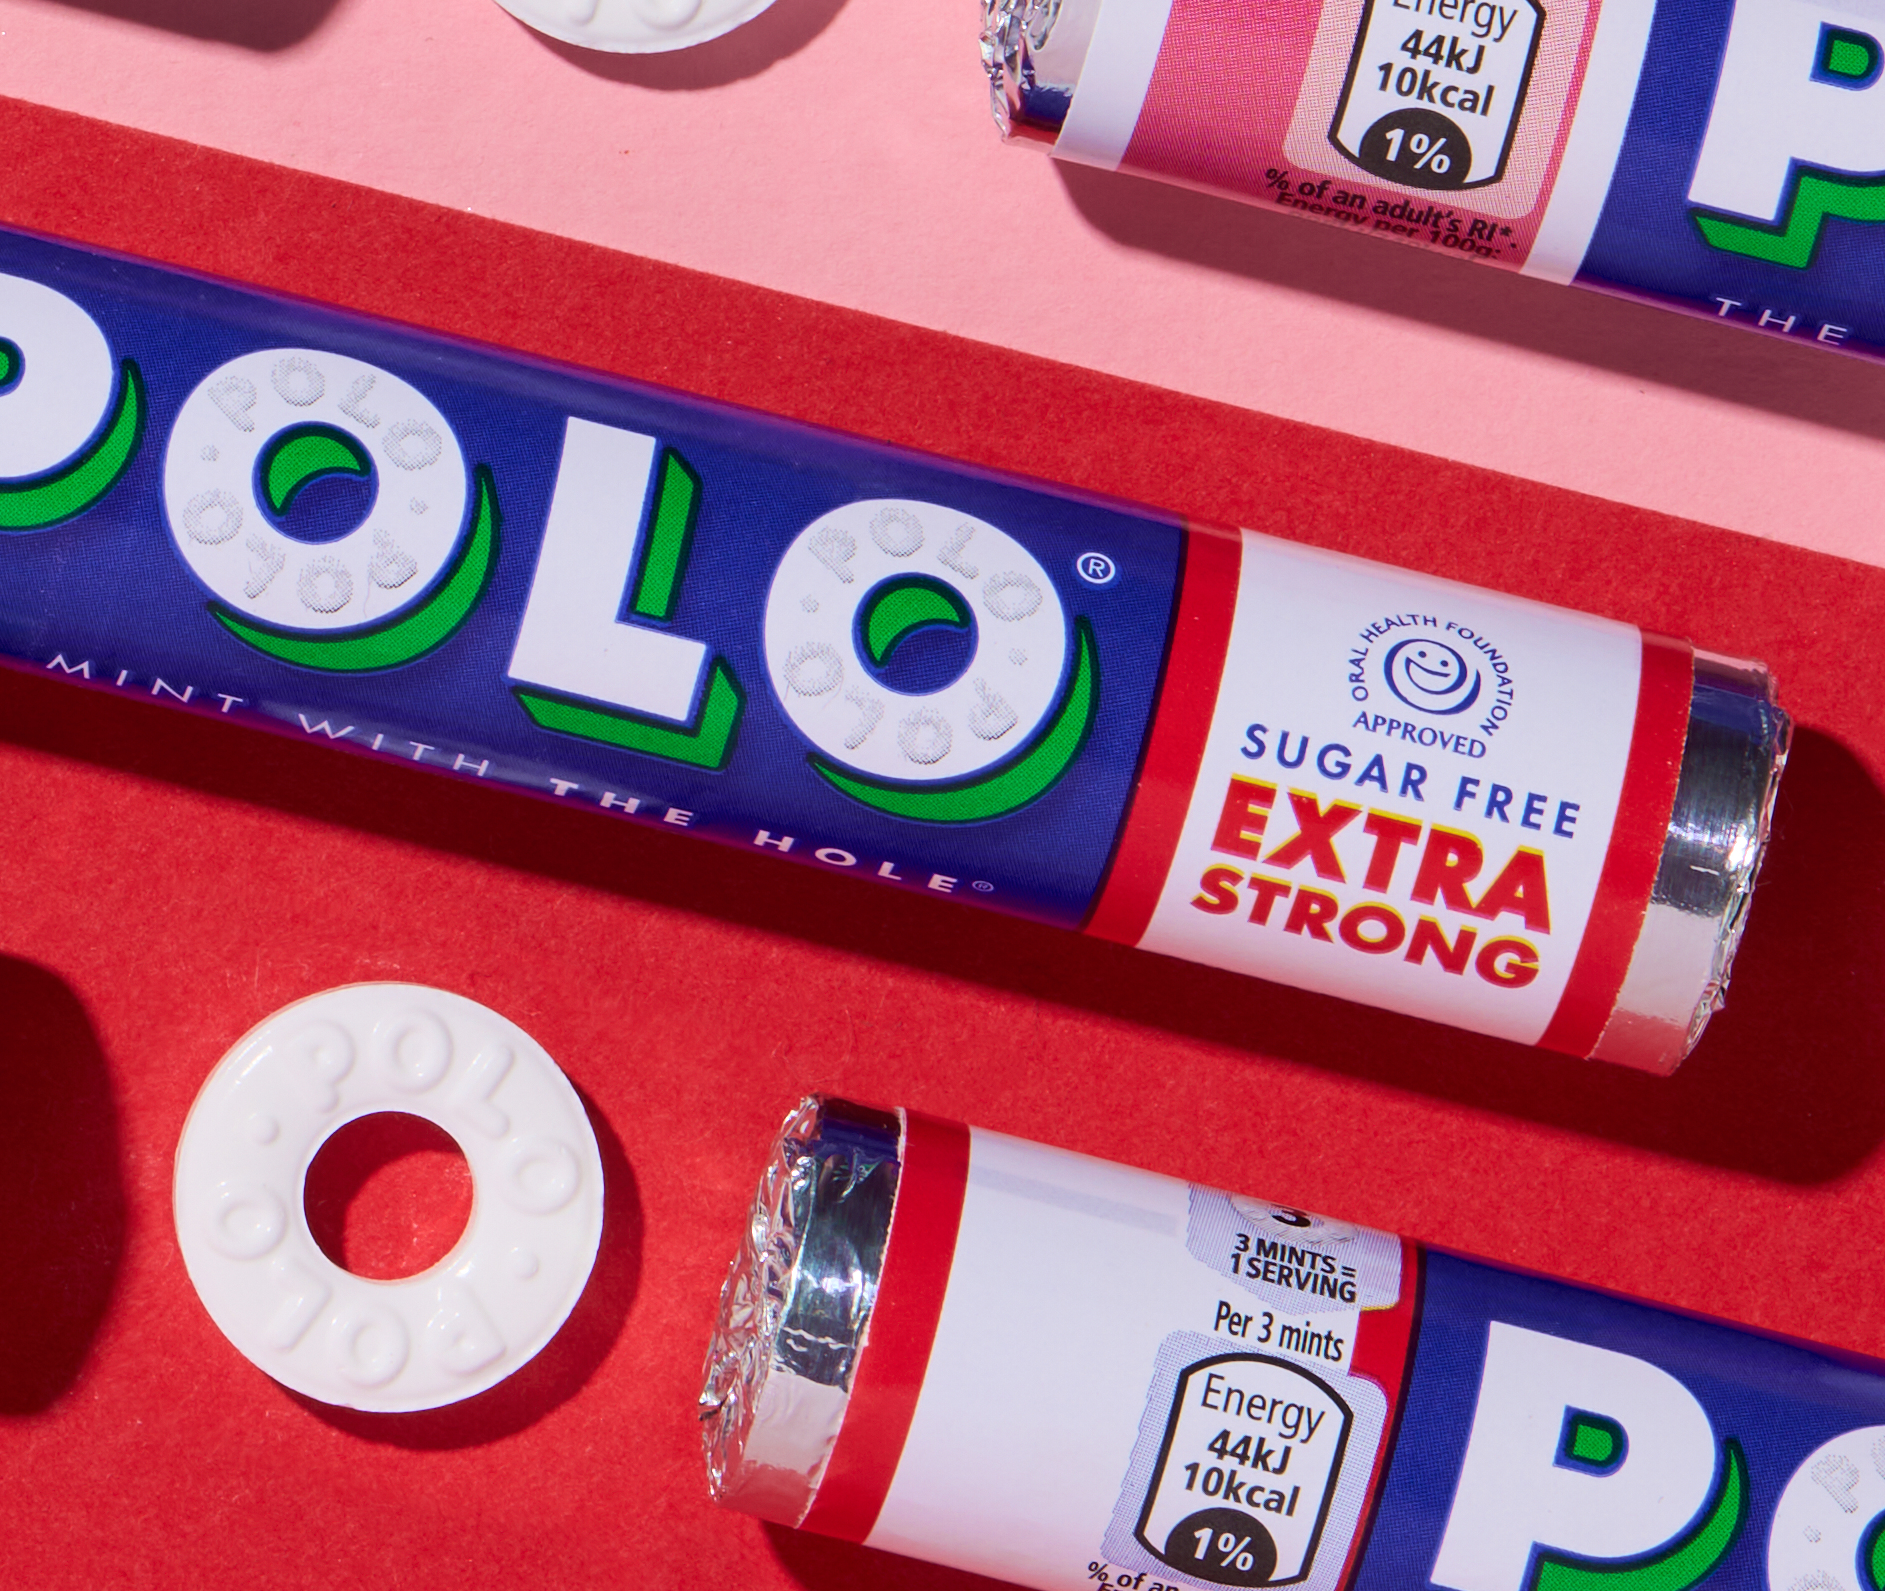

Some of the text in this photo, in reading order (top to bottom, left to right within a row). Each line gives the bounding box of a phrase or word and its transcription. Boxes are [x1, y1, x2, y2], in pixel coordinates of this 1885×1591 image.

[1400, 29, 1486, 75] 44kJ
[1378, 62, 1495, 117] 10kcal
[1385, 128, 1451, 174] 1%
[1352, 711, 1486, 759] APPROVED
[1240, 723, 1580, 838] SUGAR FREE
[1212, 773, 1552, 934] EXTRA
[1191, 863, 1540, 989] STRONG
[1201, 1373, 1326, 1444] Energy
[1207, 1429, 1292, 1475] 44kJ
[1185, 1462, 1301, 1517] 10kcal
[1194, 1527, 1254, 1571] 1%
